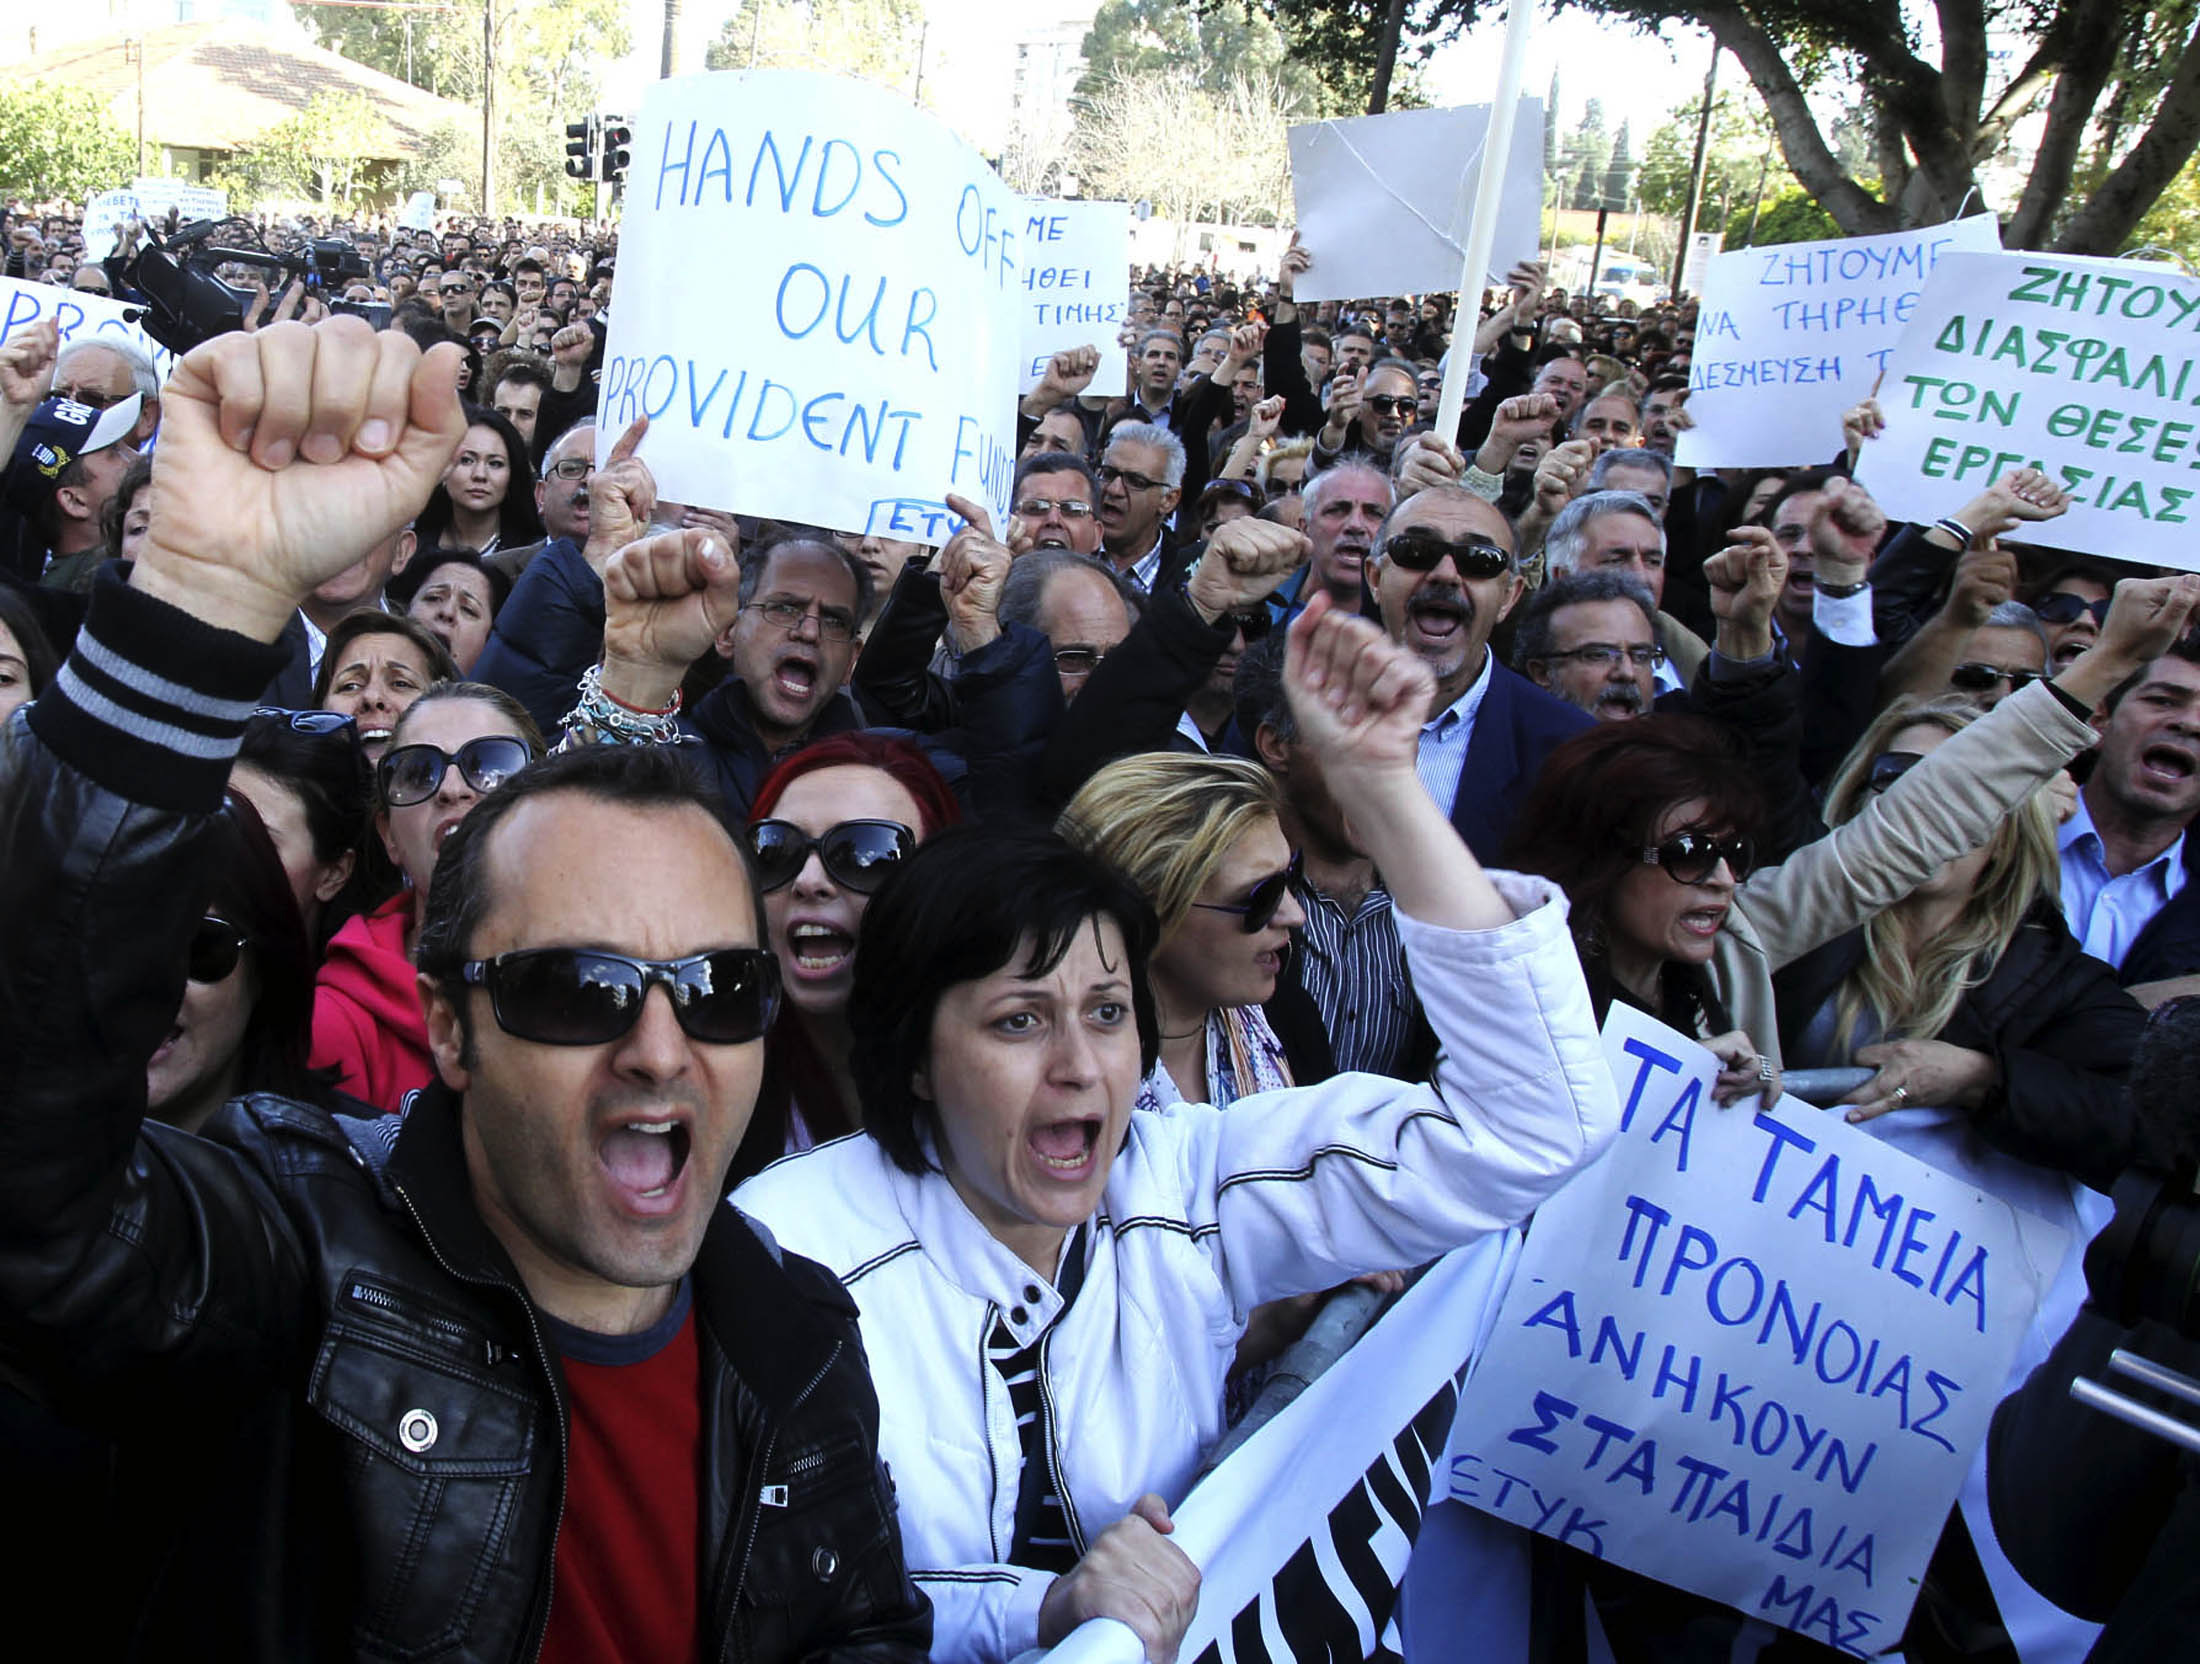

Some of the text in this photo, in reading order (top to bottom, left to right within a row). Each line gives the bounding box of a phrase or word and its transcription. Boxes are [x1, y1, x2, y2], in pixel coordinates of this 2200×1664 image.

[655, 119, 1015, 289] HANDS OFF
[775, 262, 939, 373] OUR
[1034, 303, 1121, 325] ΤΙΜΗΣ
[1698, 311, 1740, 342] ΝΑ
[2008, 266, 2200, 332] ΖΗΤΟΥ
[1691, 356, 1841, 391] ΔΕΣΜΕΥΣΗ
[1935, 315, 2200, 406] ΔΙΑΣΦΑΛΙ
[602, 354, 923, 471] PROVIDENT
[1903, 375, 2200, 470] ΤΩΝ ΘΕΣΕ
[1921, 437, 2195, 524] ΕΡΓΣΙΑΣ
[1620, 1037, 1988, 1333] ΤΑ ΤΑΜΕΙΑ
[1618, 1195, 1963, 1453] ΠΡΟΝΟΙΑΣ
[1523, 1290, 1878, 1494] ΑΝΗΚΟΥΝ
[1450, 1455, 1608, 1559] ΕΤΥΚ
[1760, 1574, 1884, 1662] ΜΑΣ
